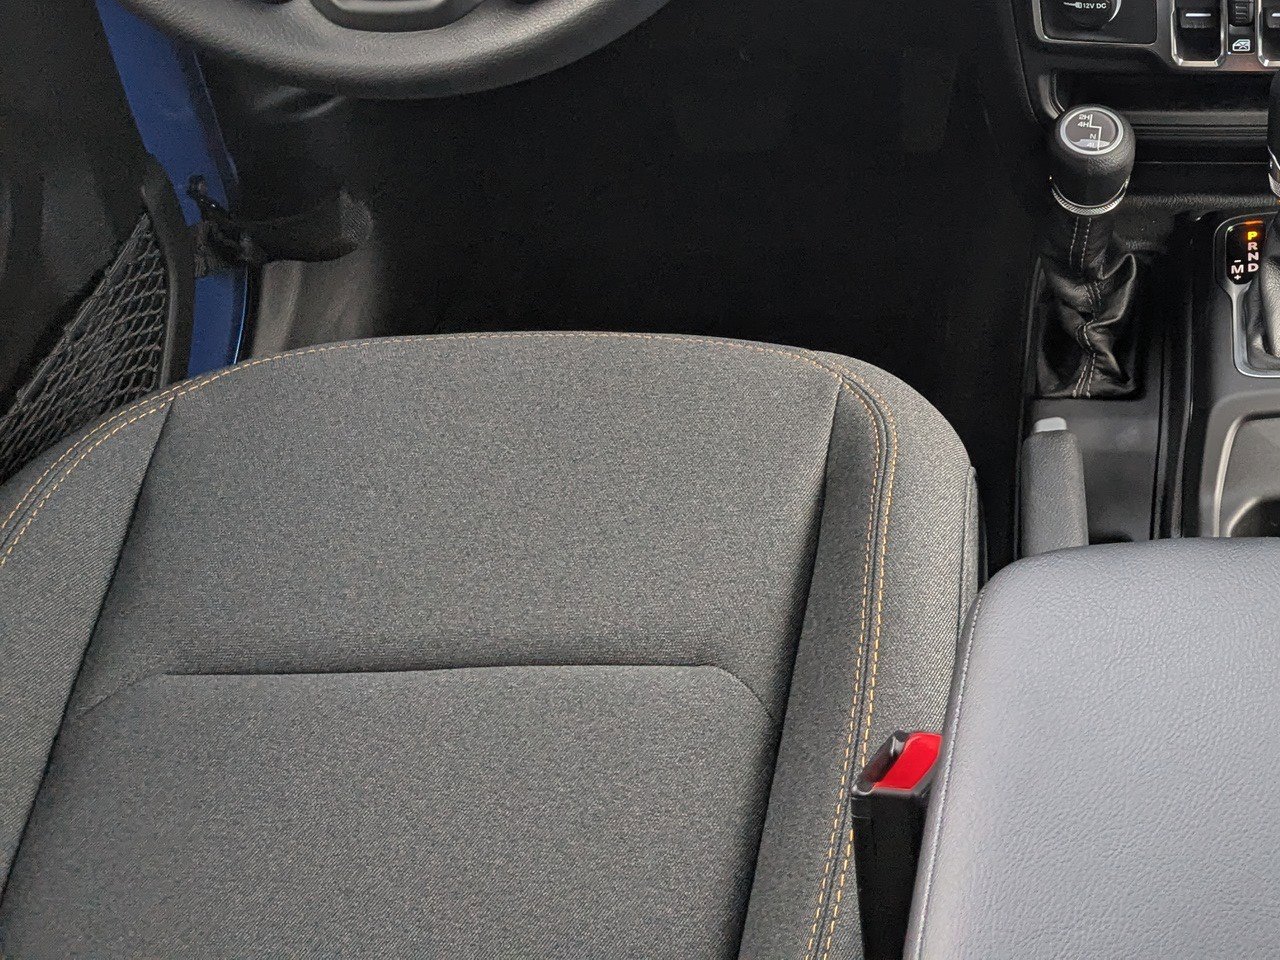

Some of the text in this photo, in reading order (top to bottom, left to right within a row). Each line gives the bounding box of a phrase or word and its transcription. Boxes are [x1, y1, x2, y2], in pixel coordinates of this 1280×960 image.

[1247, 231, 1258, 240] P
[1247, 241, 1258, 251] R
[1247, 251, 1259, 261] N
[1231, 264, 1244, 274] M
[1247, 263, 1259, 272] D
